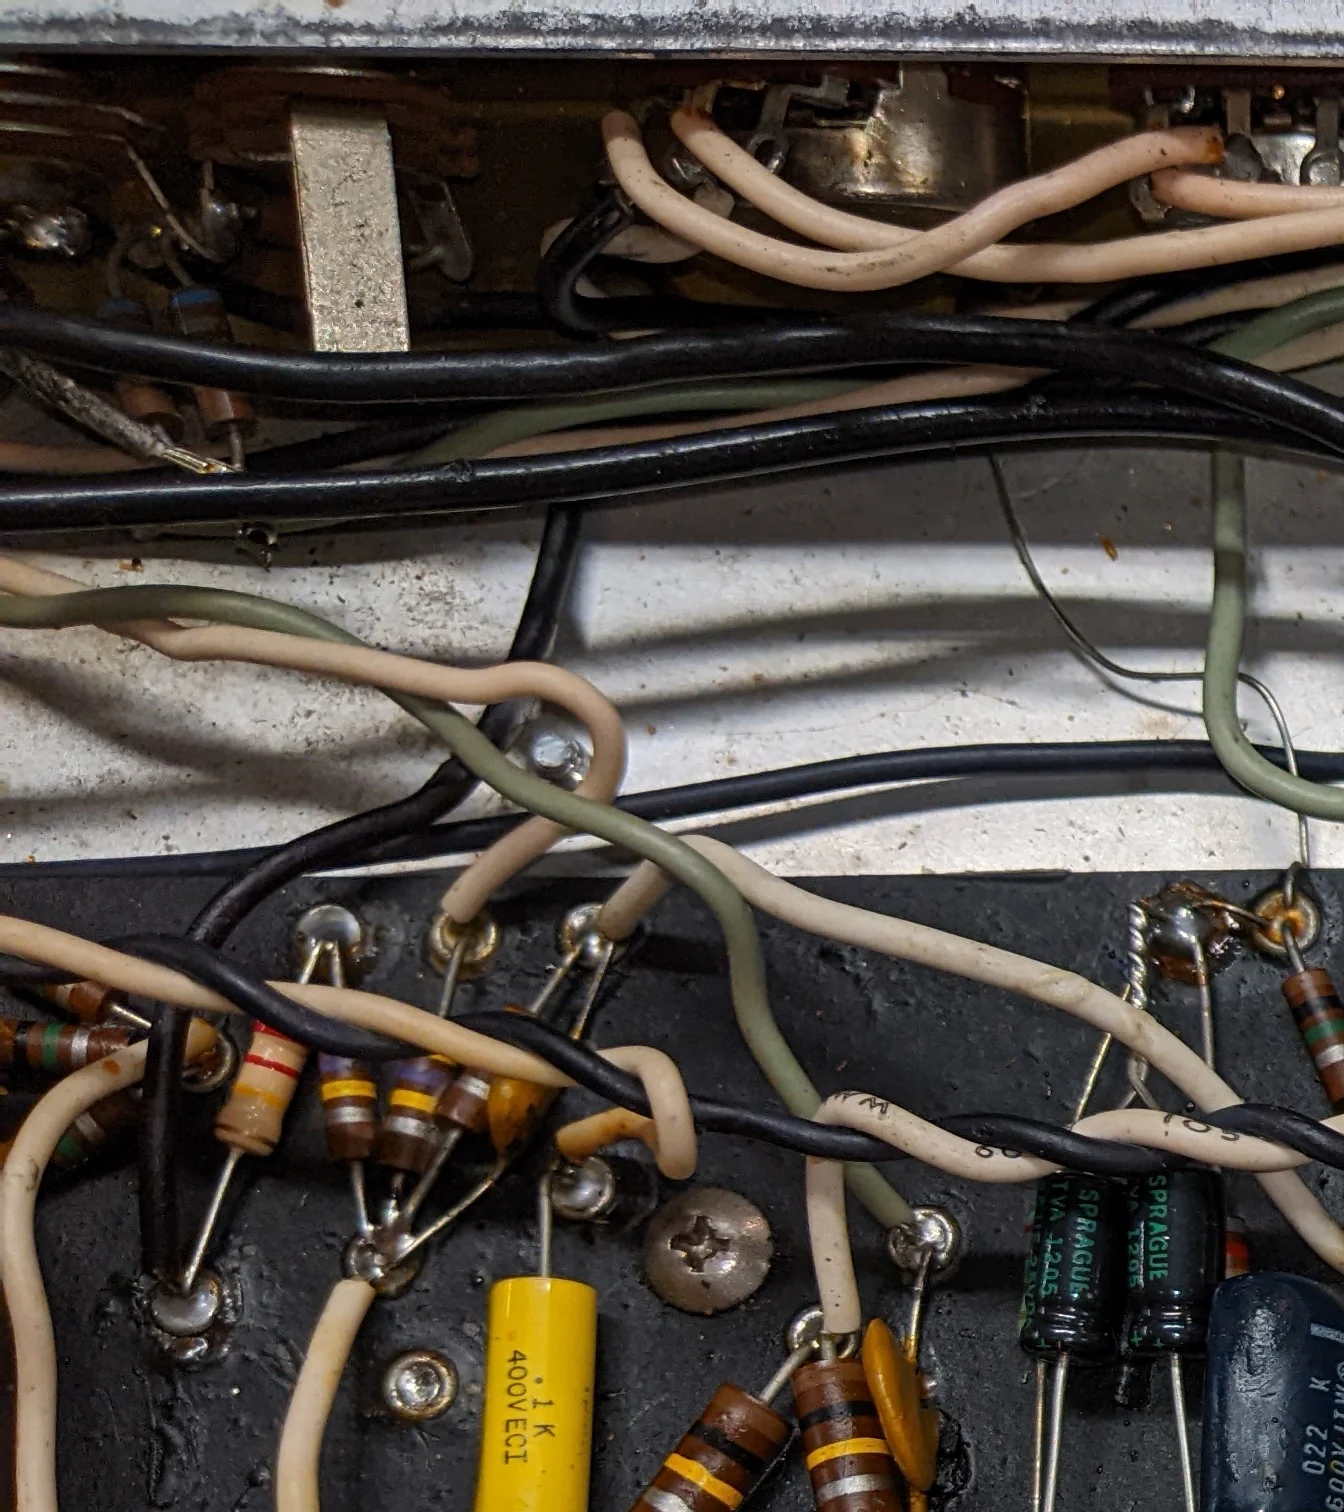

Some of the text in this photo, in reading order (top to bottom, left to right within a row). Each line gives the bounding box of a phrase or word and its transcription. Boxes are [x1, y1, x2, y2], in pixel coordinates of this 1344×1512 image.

[1068, 1188, 1099, 1298] SPRAGUE
[1148, 1174, 1169, 1282] SPRAGUE
[1308, 1376, 1332, 1393] K
[533, 1424, 557, 1438] K
